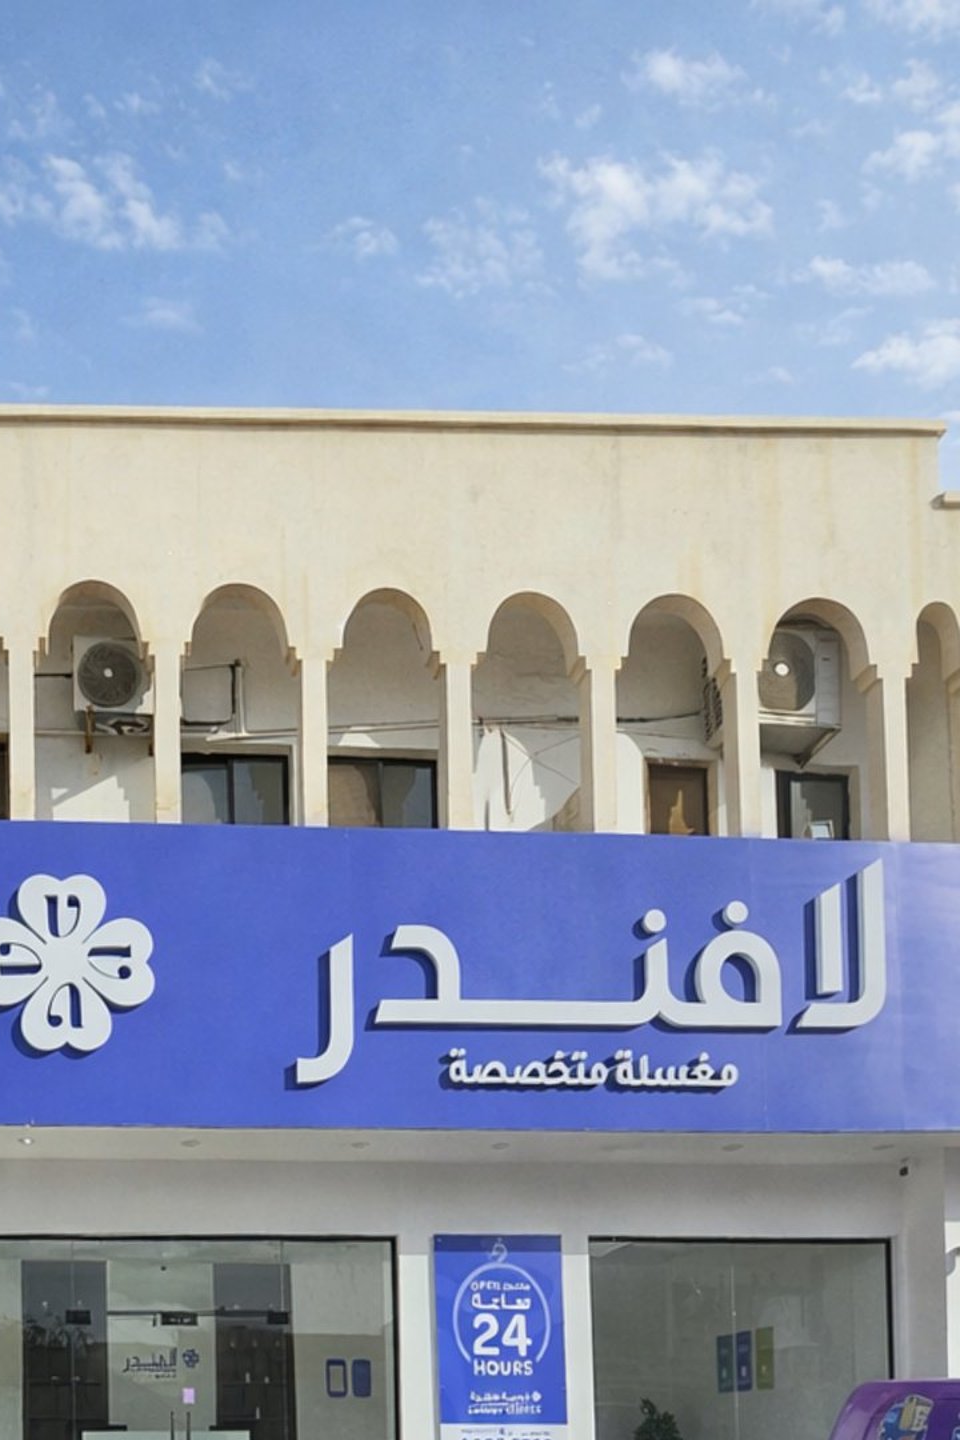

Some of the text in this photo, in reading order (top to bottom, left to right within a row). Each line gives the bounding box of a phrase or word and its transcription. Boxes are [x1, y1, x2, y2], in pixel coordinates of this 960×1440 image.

[296, 858, 887, 1085] لافندر
[448, 1047, 739, 1087] مغسلة متخصصة
[472, 1312, 533, 1358] 24
[473, 1358, 534, 1376] HOURS
